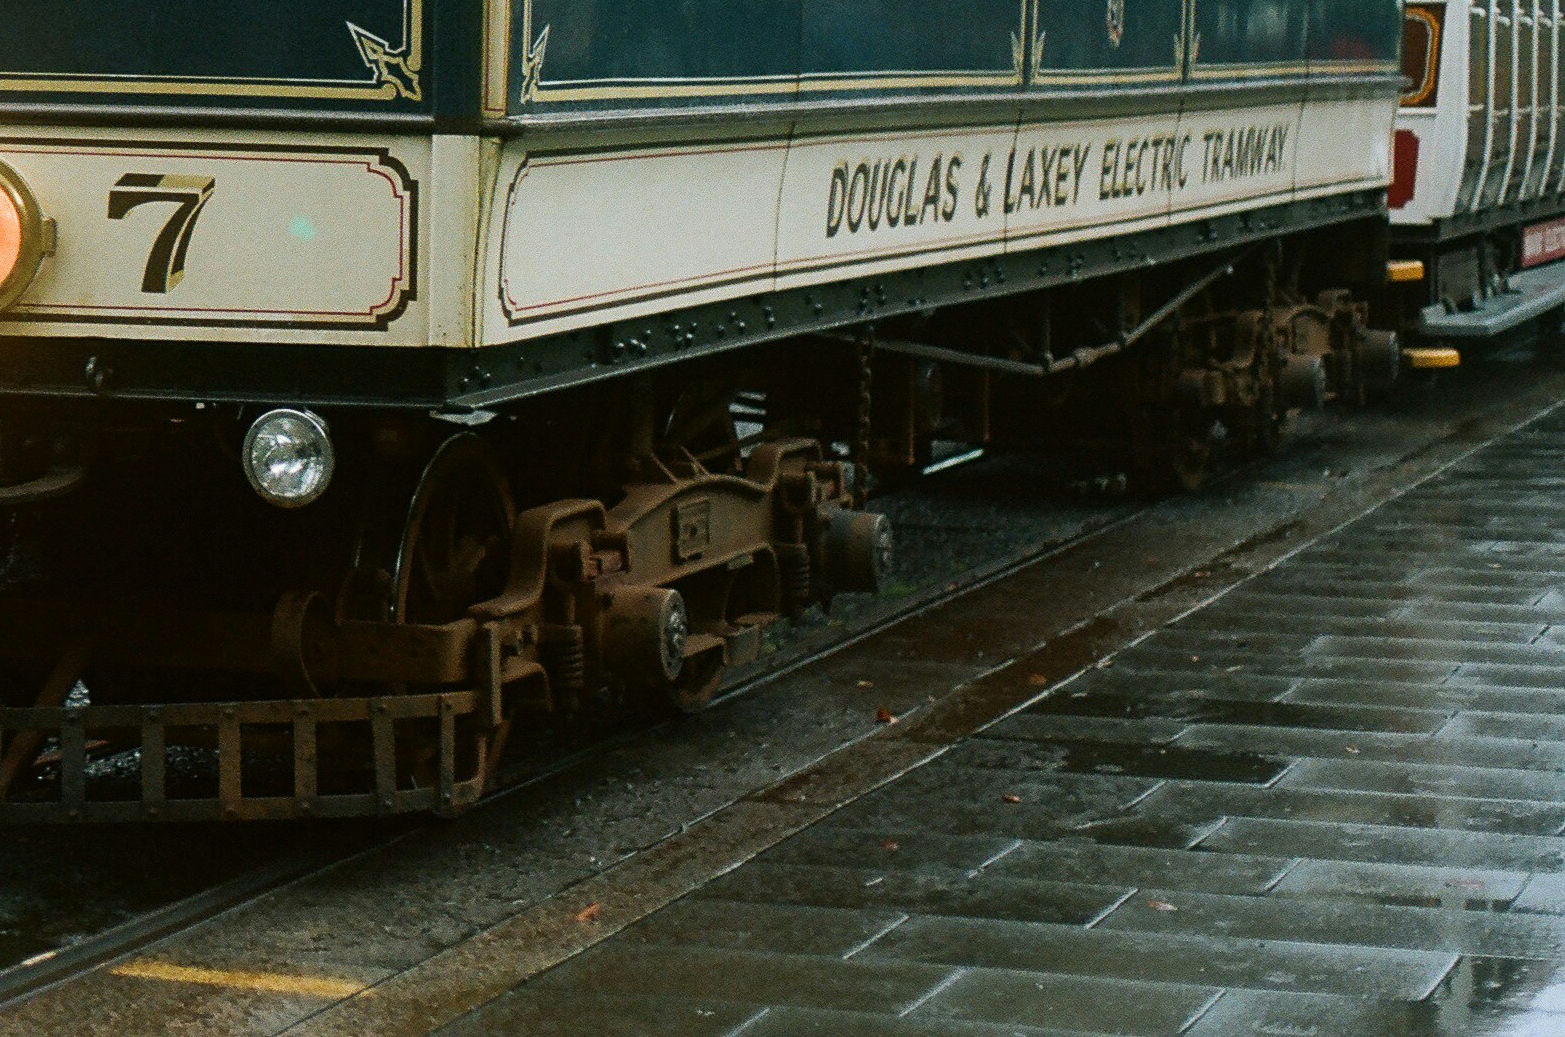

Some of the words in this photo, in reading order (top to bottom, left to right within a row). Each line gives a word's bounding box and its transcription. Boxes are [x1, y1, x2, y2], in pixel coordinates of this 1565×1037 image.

[107, 172, 215, 294] 7
[826, 152, 963, 238] DOUGLAS
[975, 149, 991, 218] &
[1004, 142, 1090, 214] LAXEY
[1099, 130, 1191, 200] ELECTRIC
[1201, 122, 1289, 183] TRAMWAY
